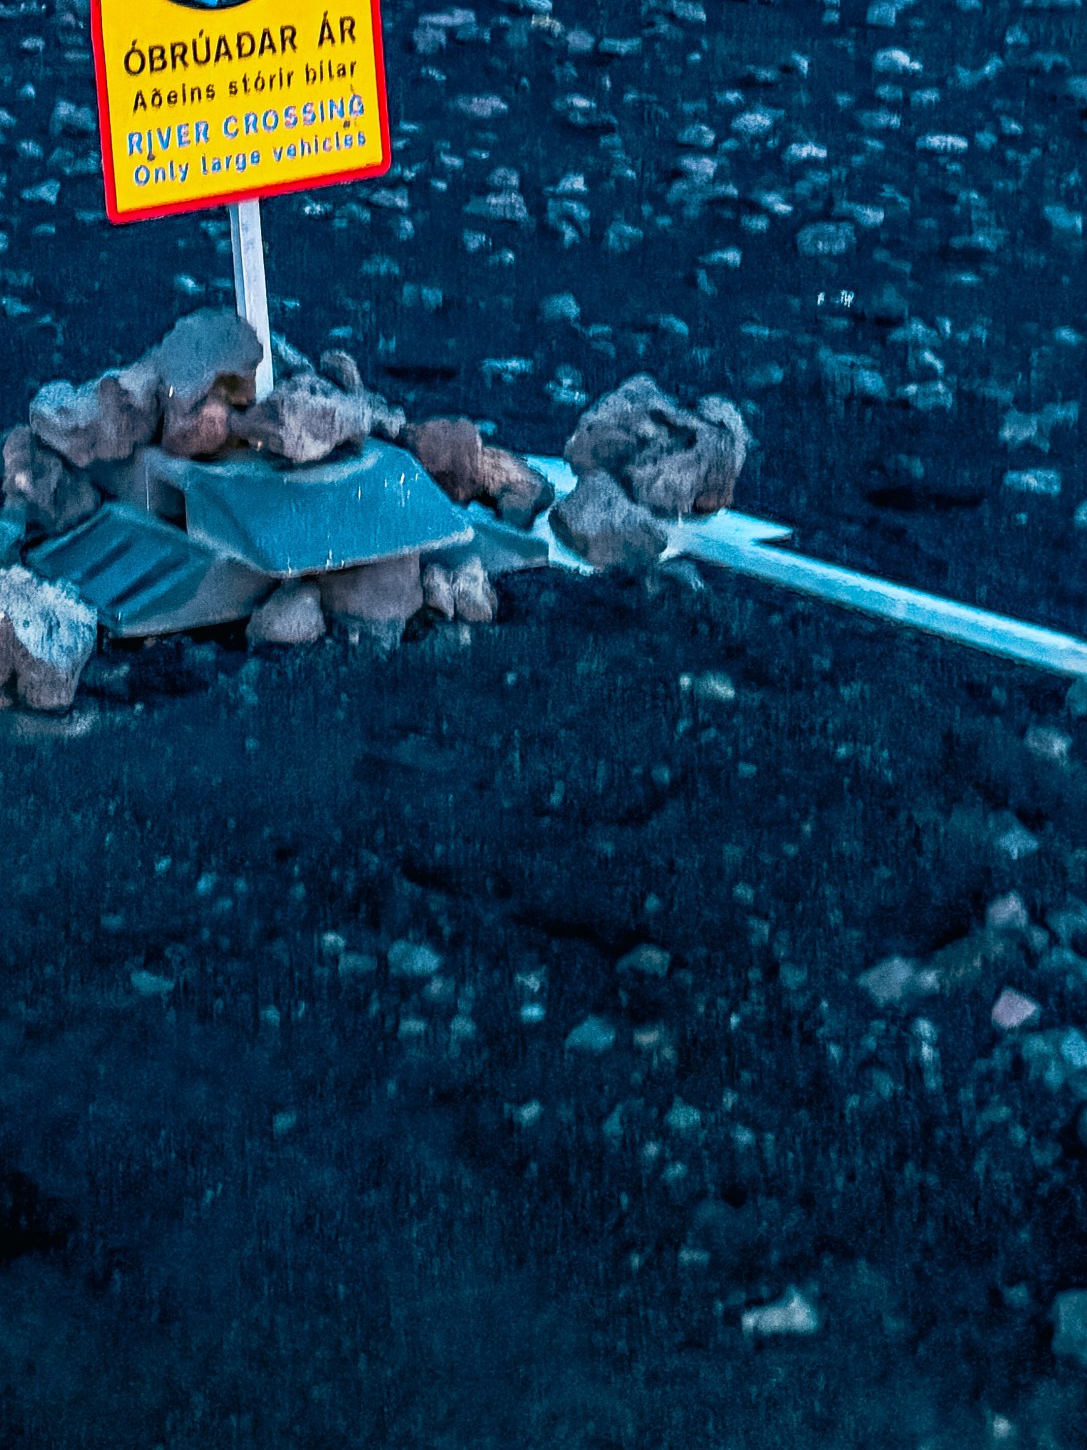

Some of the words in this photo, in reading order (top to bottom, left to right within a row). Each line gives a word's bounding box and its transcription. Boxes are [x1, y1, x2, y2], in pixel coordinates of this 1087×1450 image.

[318, 10, 356, 49] ÁR
[133, 83, 216, 115] Aðeins
[228, 66, 294, 96] stórir
[127, 120, 210, 156] RIVER
[222, 94, 365, 139] CROSSING
[134, 160, 189, 187] Only
[201, 150, 261, 176] large
[272, 130, 367, 163] vehicles
